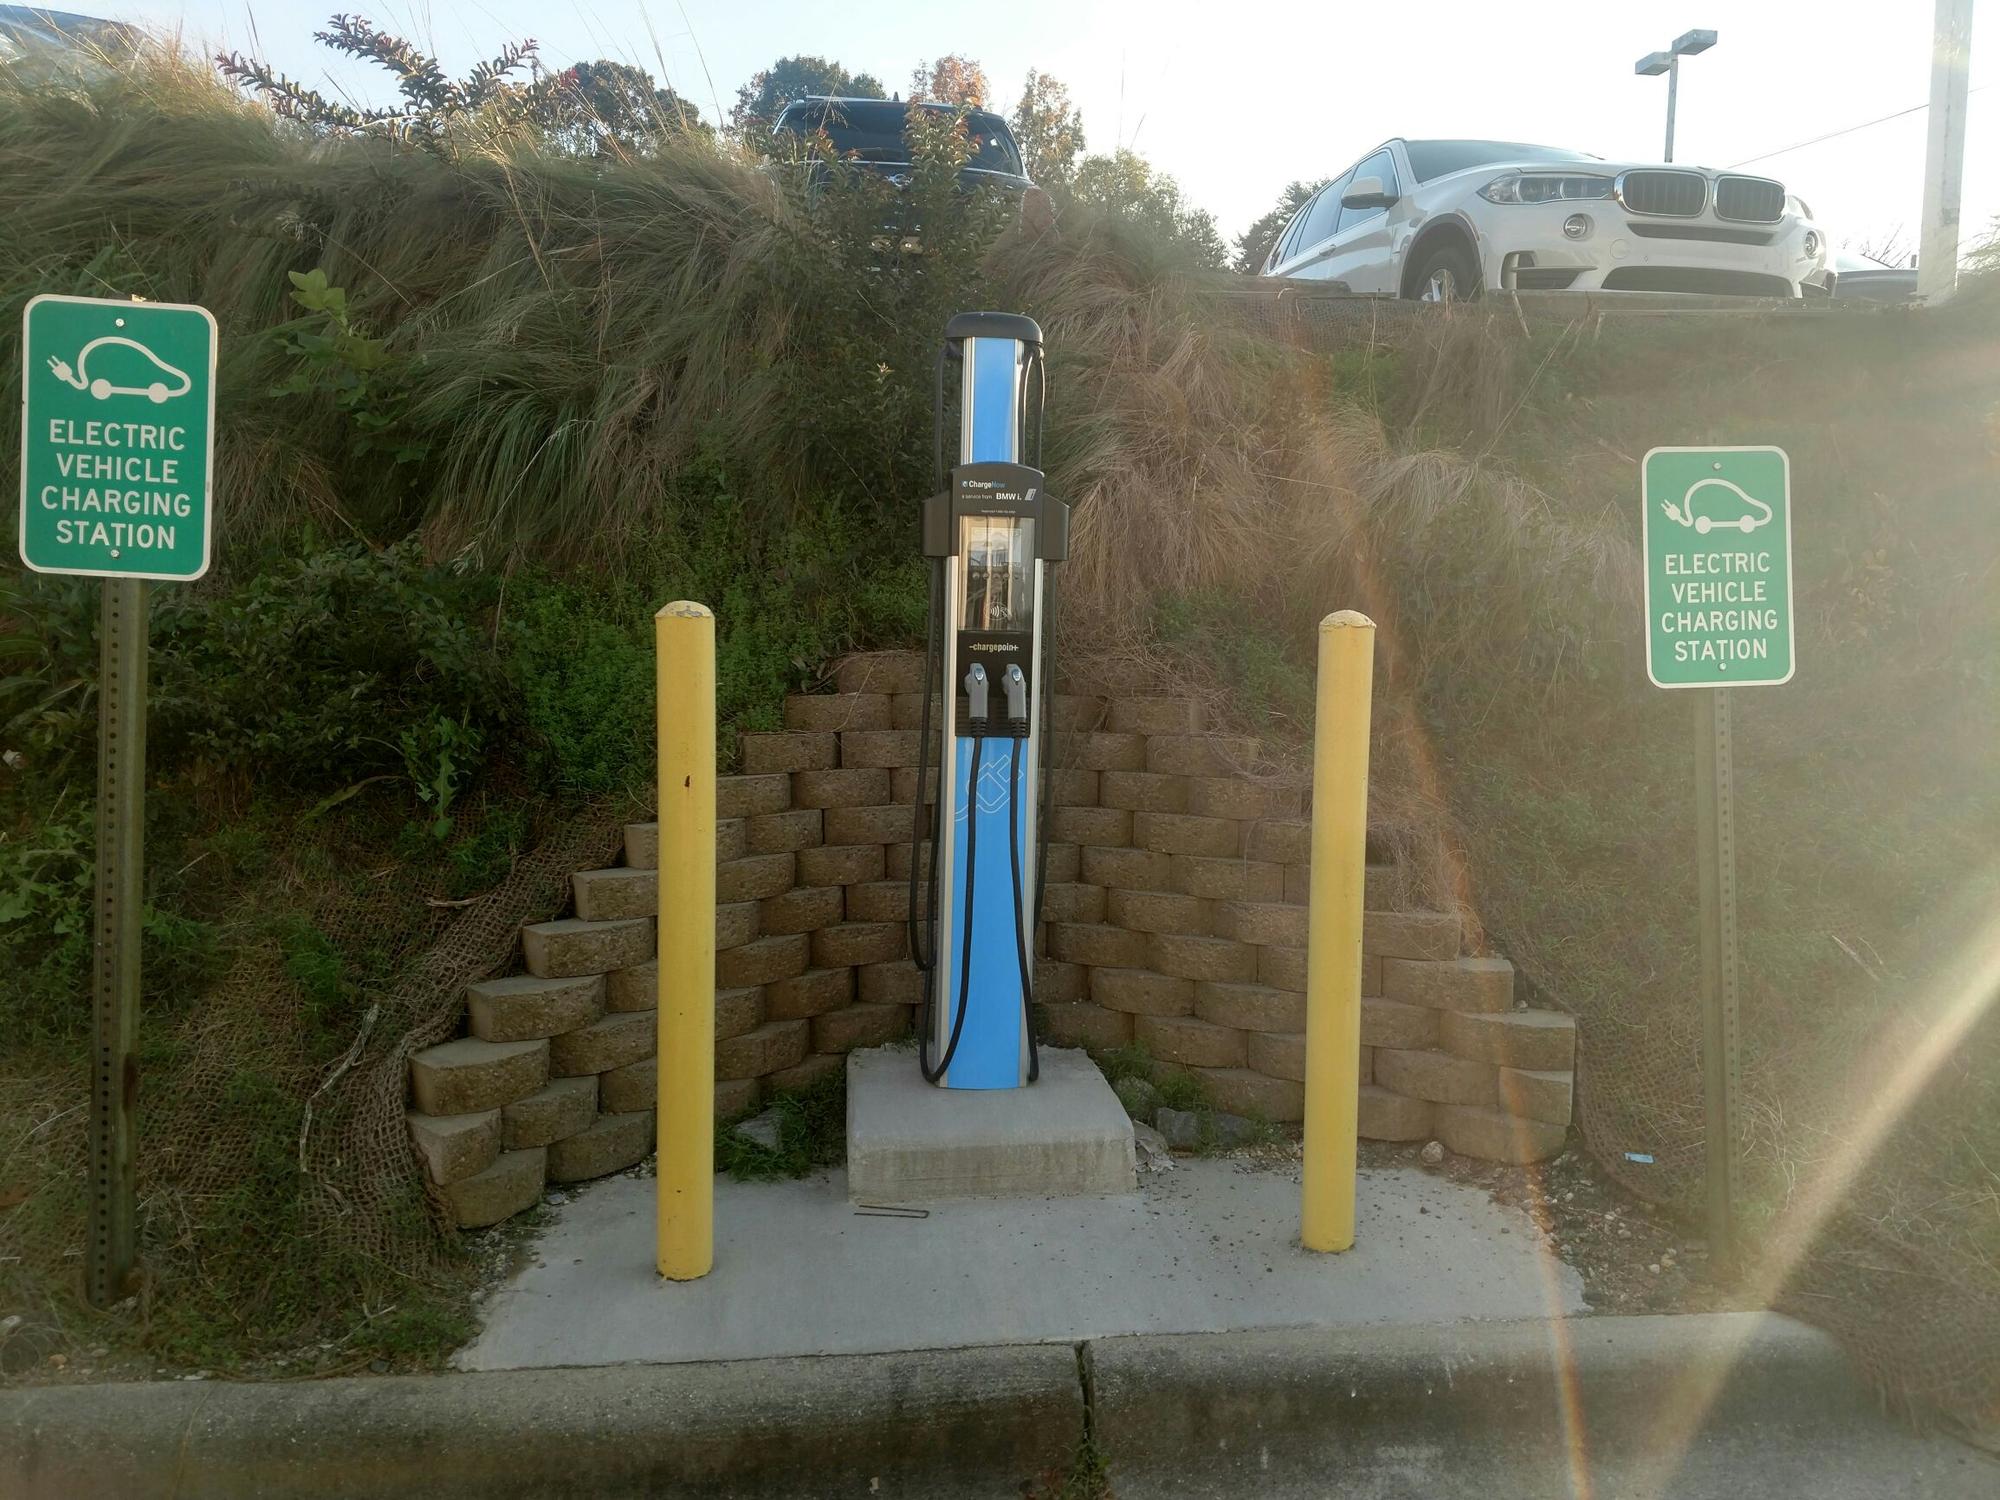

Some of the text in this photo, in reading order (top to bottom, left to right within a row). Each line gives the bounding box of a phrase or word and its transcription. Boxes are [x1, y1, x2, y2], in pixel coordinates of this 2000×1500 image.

[49, 419, 186, 451] ELECTRIC
[56, 452, 179, 484] VEHICLE
[40, 485, 192, 517] CHARGING
[995, 492, 1017, 500] BMW
[55, 519, 175, 550] STATION
[1664, 552, 1771, 575] ELECTRIC
[1671, 580, 1767, 604] VEHICLE
[1661, 609, 1778, 633] CHARGING
[1674, 638, 1767, 662] STATION
